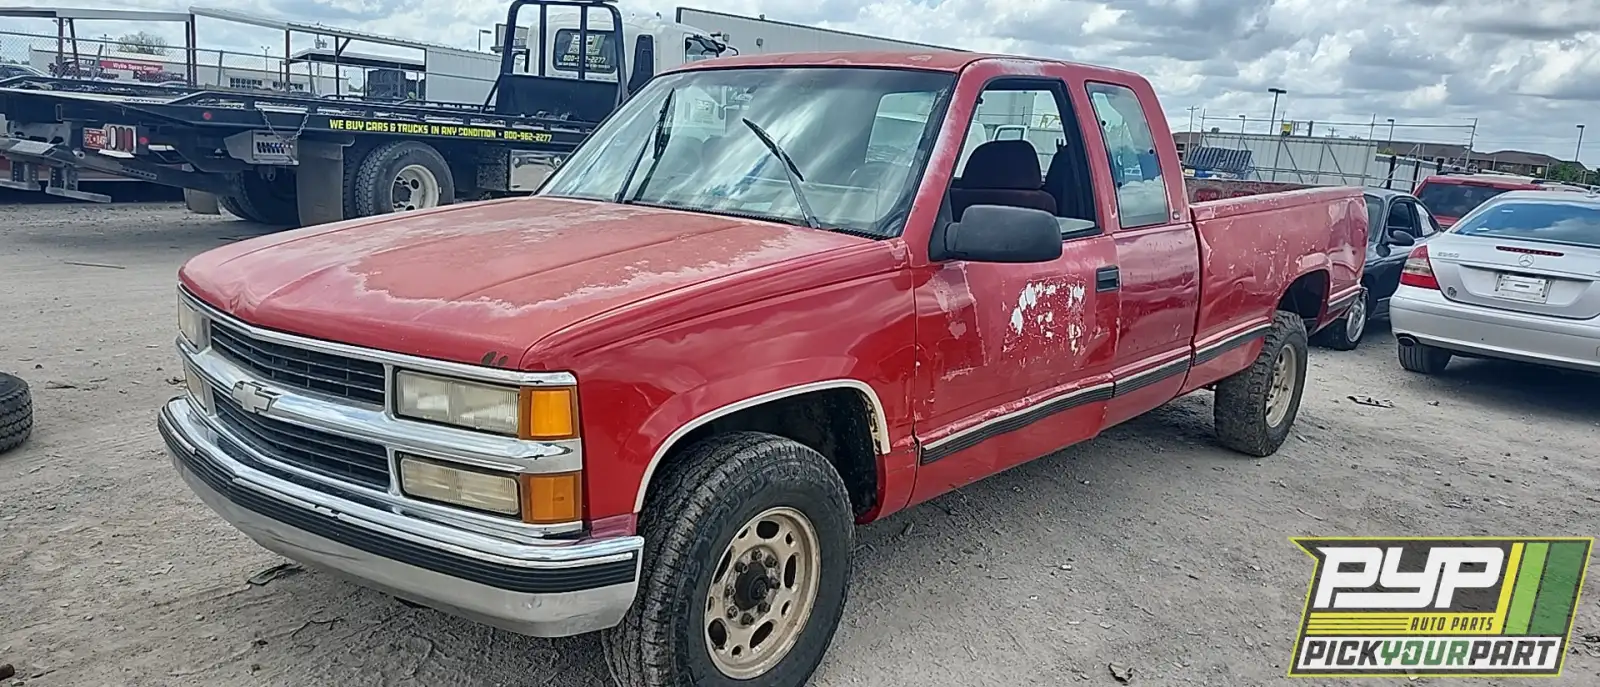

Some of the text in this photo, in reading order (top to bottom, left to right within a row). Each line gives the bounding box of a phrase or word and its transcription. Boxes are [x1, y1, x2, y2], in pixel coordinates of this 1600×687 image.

[329, 119, 552, 142] WE BUY CARS & TRUCKS IN ANY CONDITION 800-962-2277
